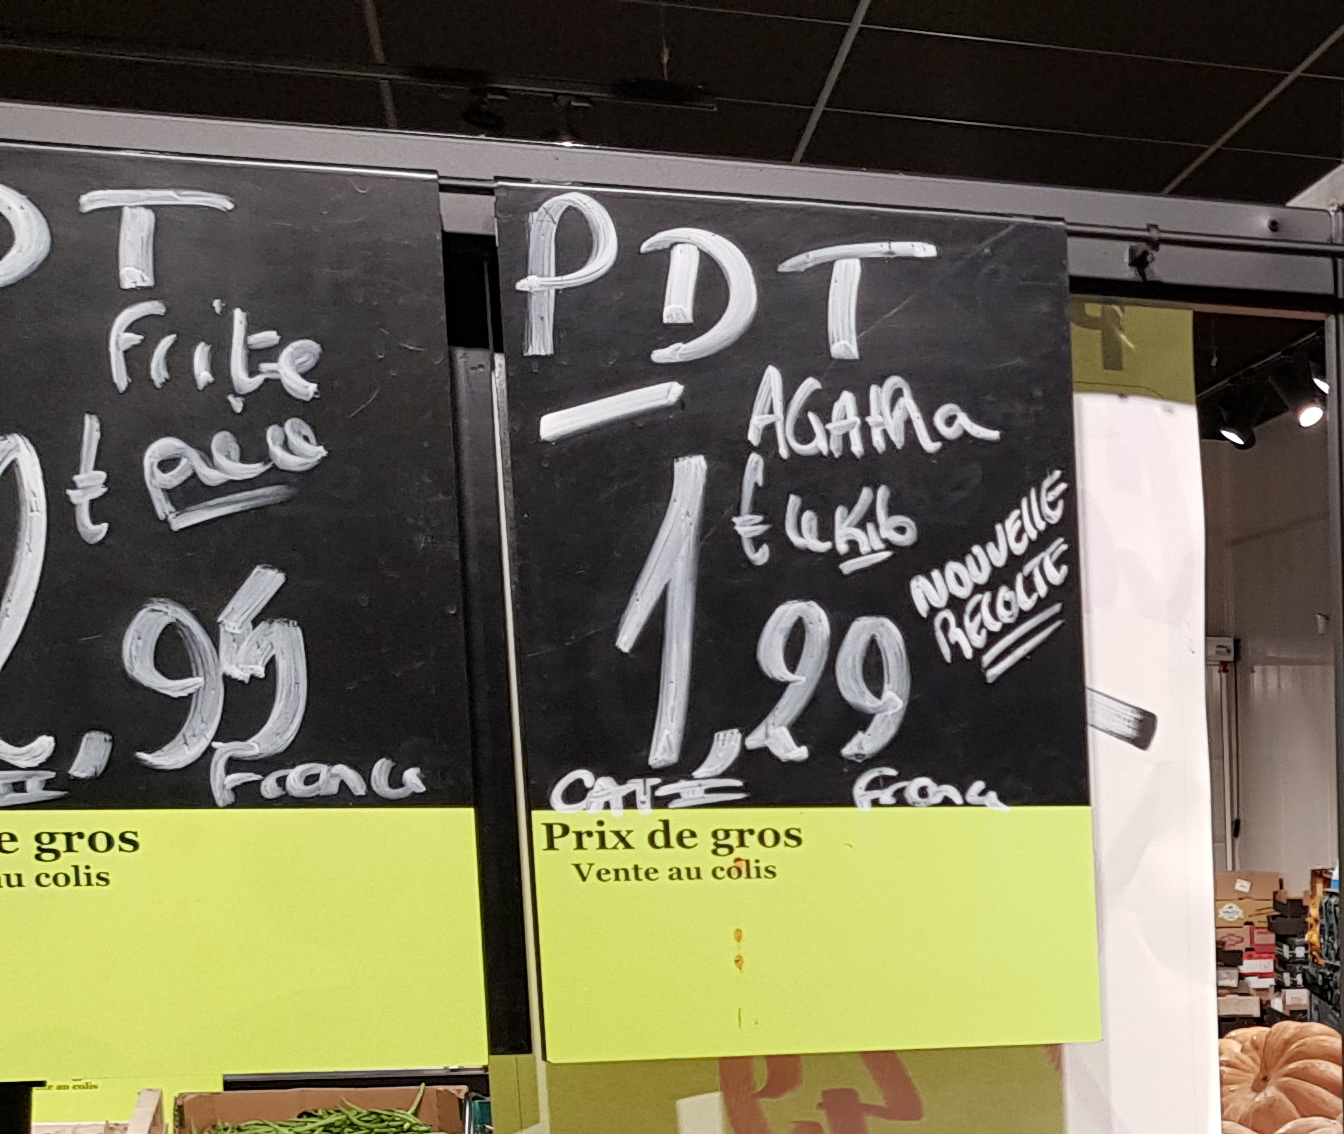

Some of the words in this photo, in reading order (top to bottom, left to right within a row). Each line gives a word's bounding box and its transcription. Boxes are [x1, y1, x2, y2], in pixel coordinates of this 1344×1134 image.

[516, 191, 937, 363] PDT
[615, 455, 912, 778] 1,99
[550, 768, 661, 815] CAT
[34, 828, 140, 862] gros
[541, 819, 636, 851] Prix
[647, 818, 699, 851] de
[710, 824, 803, 857] gros
[35, 864, 111, 889] colis
[571, 862, 659, 883] Vente
[667, 864, 703, 881] au
[710, 856, 778, 882] colis
